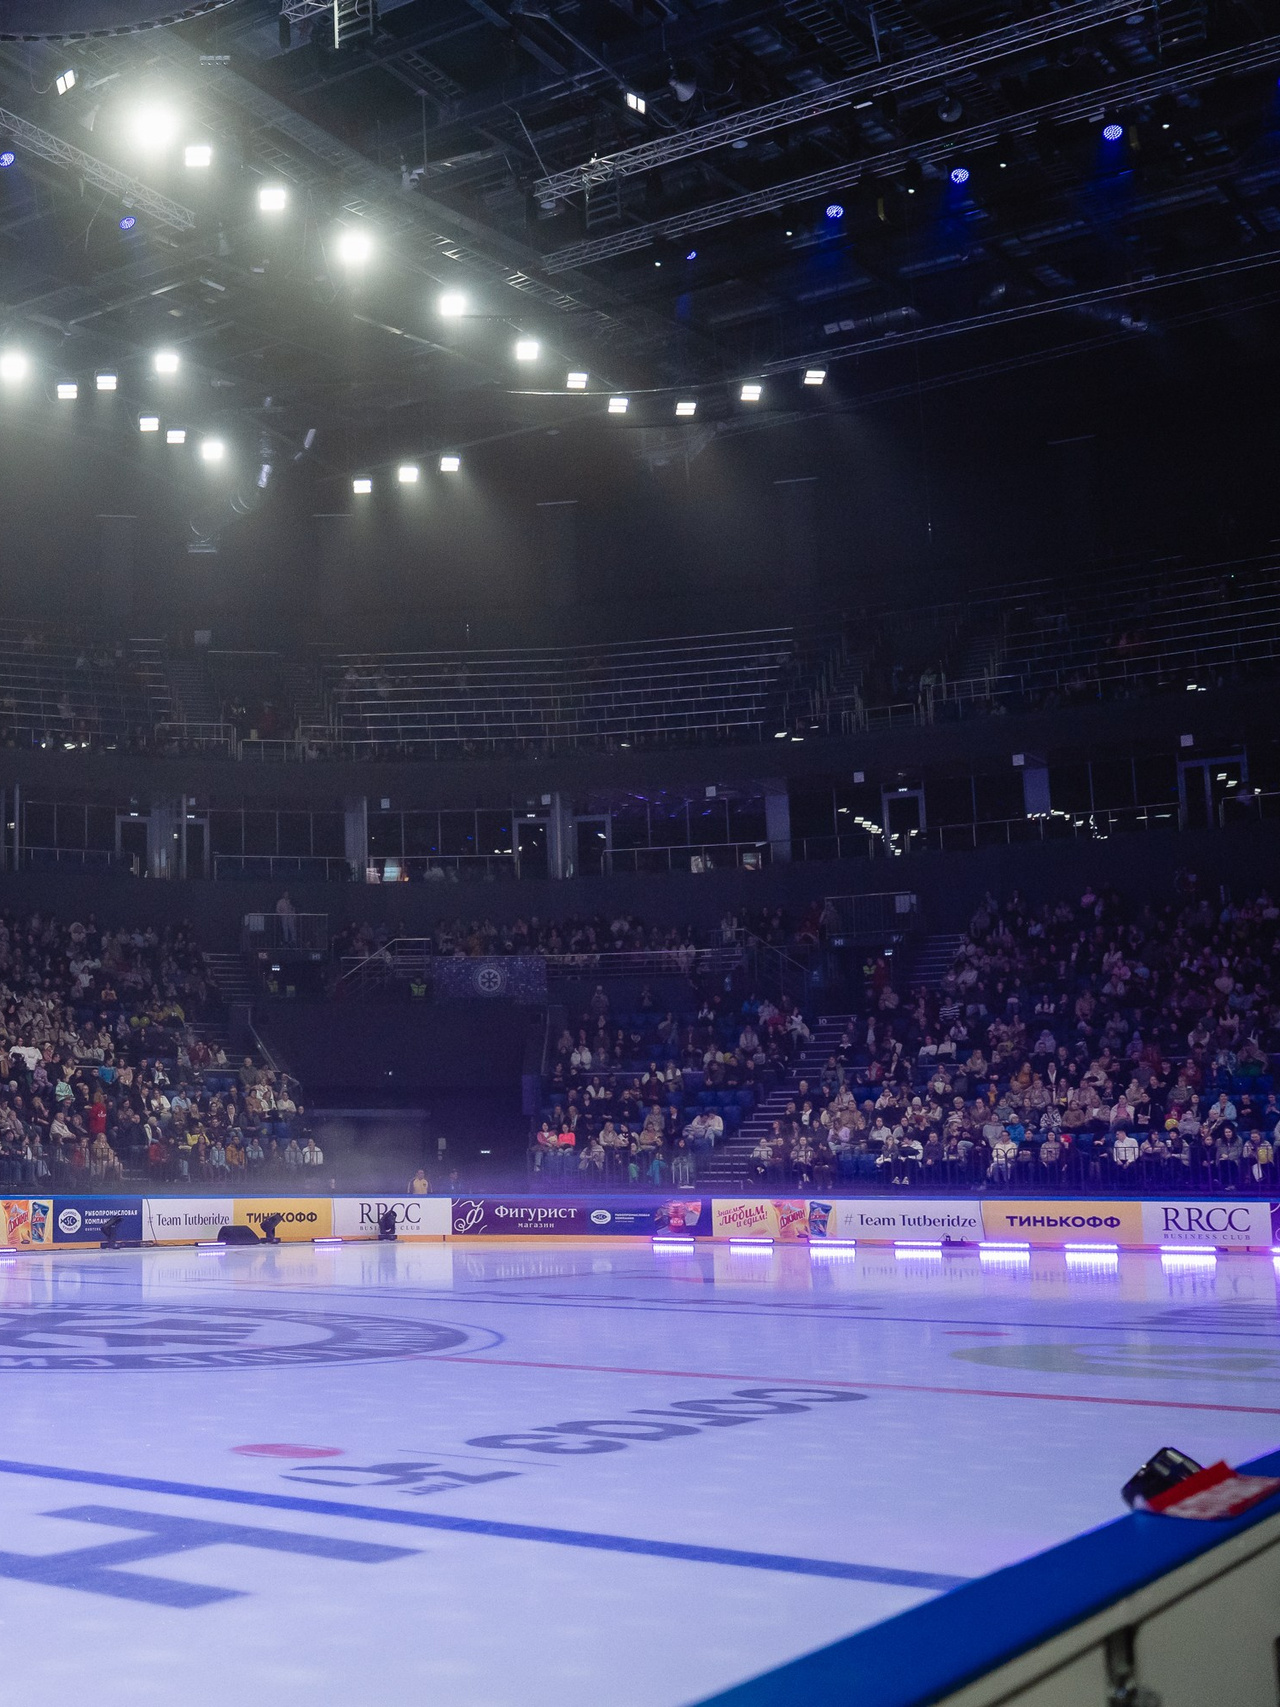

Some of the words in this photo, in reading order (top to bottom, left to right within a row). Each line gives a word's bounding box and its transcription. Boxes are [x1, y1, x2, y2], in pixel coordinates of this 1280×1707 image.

[792, 1069, 797, 1077] 7
[156, 1213, 182, 1226] Team
[183, 1212, 230, 1226] Tutberidze
[246, 1212, 318, 1224] ТИНКОФФ
[494, 1204, 578, 1222] Фигурист
[719, 1204, 765, 1227] любим
[743, 1211, 768, 1228] едим!
[1161, 1206, 1251, 1232] RRCC
[857, 1213, 896, 1227] Team
[898, 1214, 977, 1228] Tutberidze
[1006, 1215, 1121, 1229] ТИНЬКОФФ
[1163, 1232, 1218, 1240] BUSINESS
[1223, 1233, 1251, 1241] CLUB
